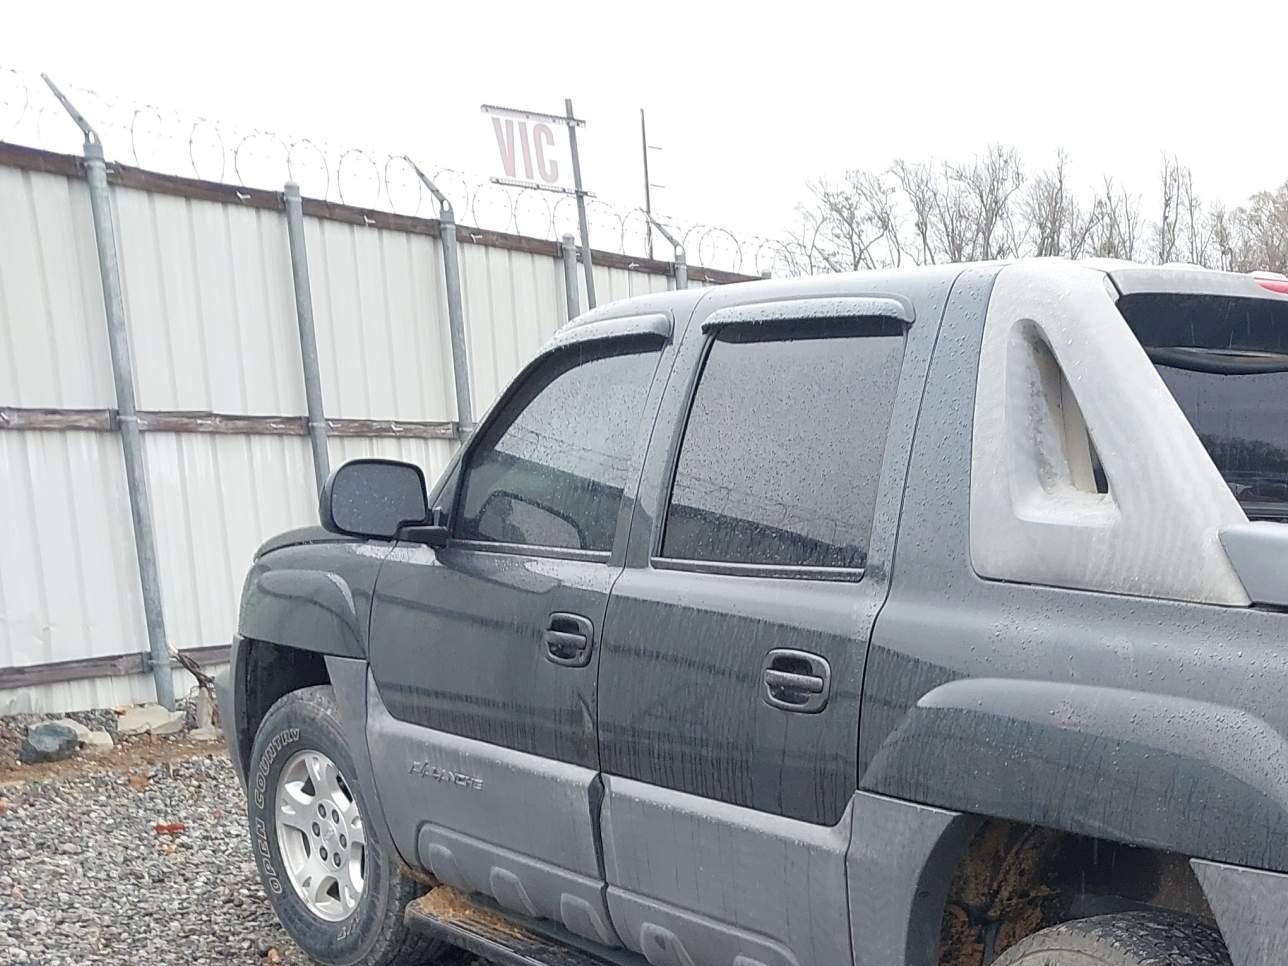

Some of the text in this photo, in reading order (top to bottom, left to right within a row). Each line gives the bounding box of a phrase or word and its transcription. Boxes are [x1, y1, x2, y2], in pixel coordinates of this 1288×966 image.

[491, 116, 559, 184] VIC
[255, 727, 300, 894] OPEN COUNTRY
